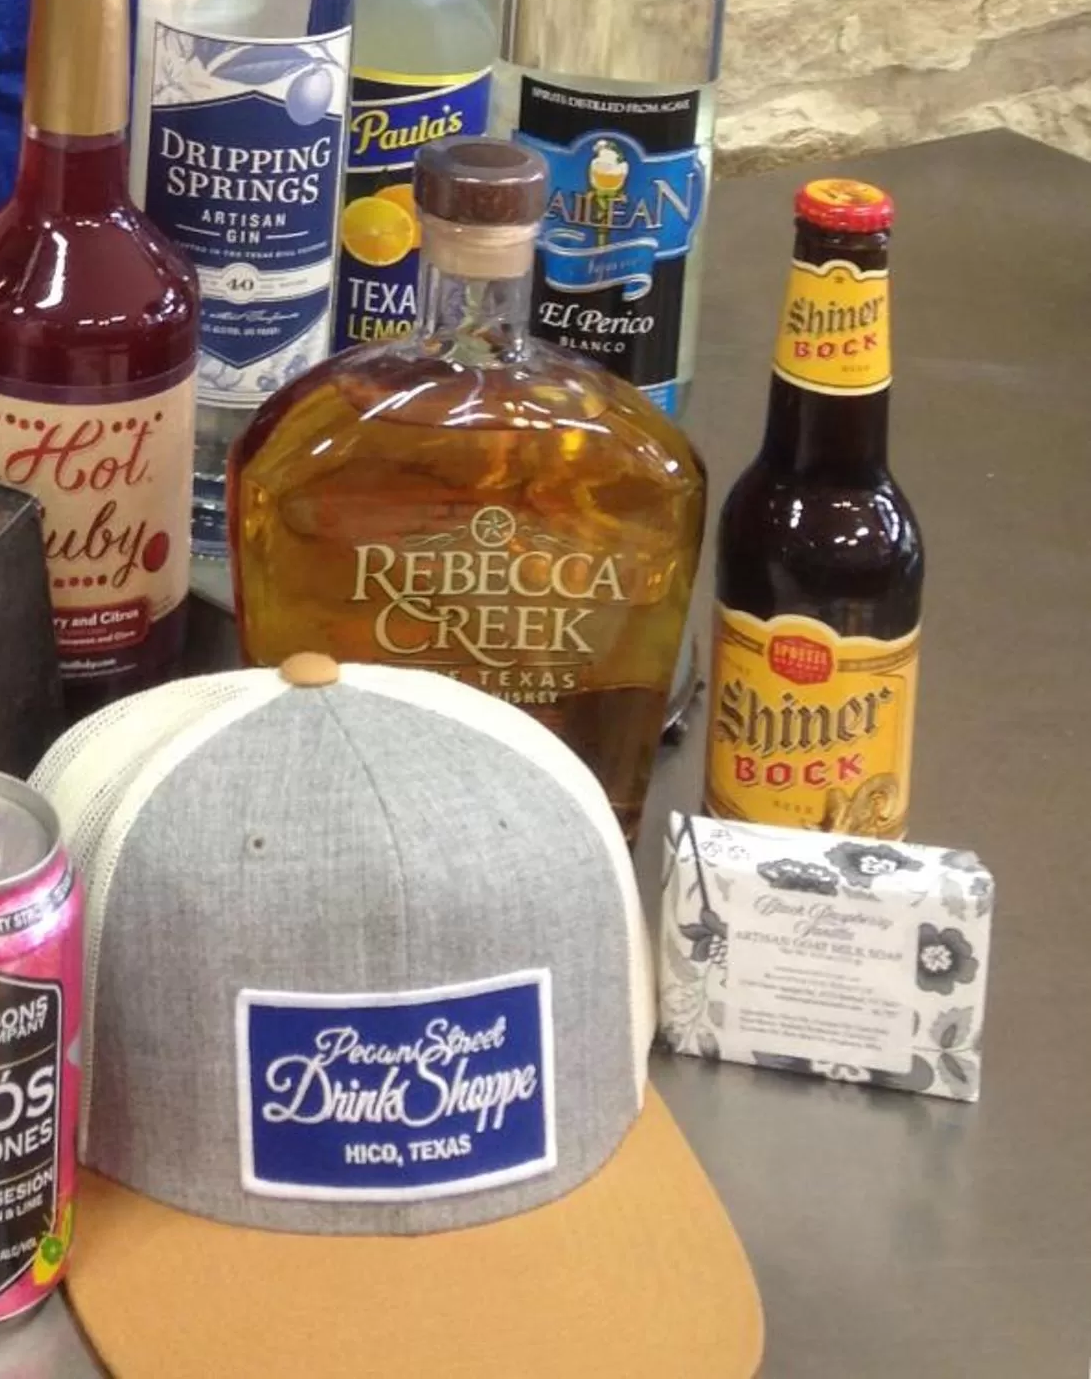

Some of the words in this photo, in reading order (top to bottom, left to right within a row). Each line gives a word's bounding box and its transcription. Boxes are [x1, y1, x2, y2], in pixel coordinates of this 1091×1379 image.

[351, 104, 464, 155] Paula's
[160, 128, 332, 175] DRIPPING
[166, 167, 320, 205] SPRINGS
[540, 172, 695, 229] AILEAN
[201, 209, 287, 227] ARTISAN
[225, 227, 261, 245] GIN
[226, 278, 254, 292] 40
[348, 276, 418, 316] TEXA
[538, 301, 575, 328] El
[576, 308, 655, 335] Perico
[784, 294, 886, 339] Shiner
[559, 335, 627, 354] BLANCO
[793, 333, 879, 360] BOCK
[5, 418, 153, 492] Hot
[41, 500, 147, 589] uby
[350, 543, 629, 607] REBECCA
[71, 612, 98, 628] and
[373, 596, 597, 667] CREEK
[477, 670, 576, 689] TEXAS
[492, 690, 560, 704] ISKEY
[714, 679, 894, 757] Shiner
[734, 753, 864, 788] BOCK
[316, 1025, 418, 1065] Pecan
[416, 1015, 507, 1065] Street
[262, 1054, 405, 1124] Drink
[400, 1058, 538, 1133] Shoppe
[344, 1143, 405, 1167] HICO,
[407, 1133, 472, 1163] TEXAS
[16, 1193, 44, 1217] LIME
